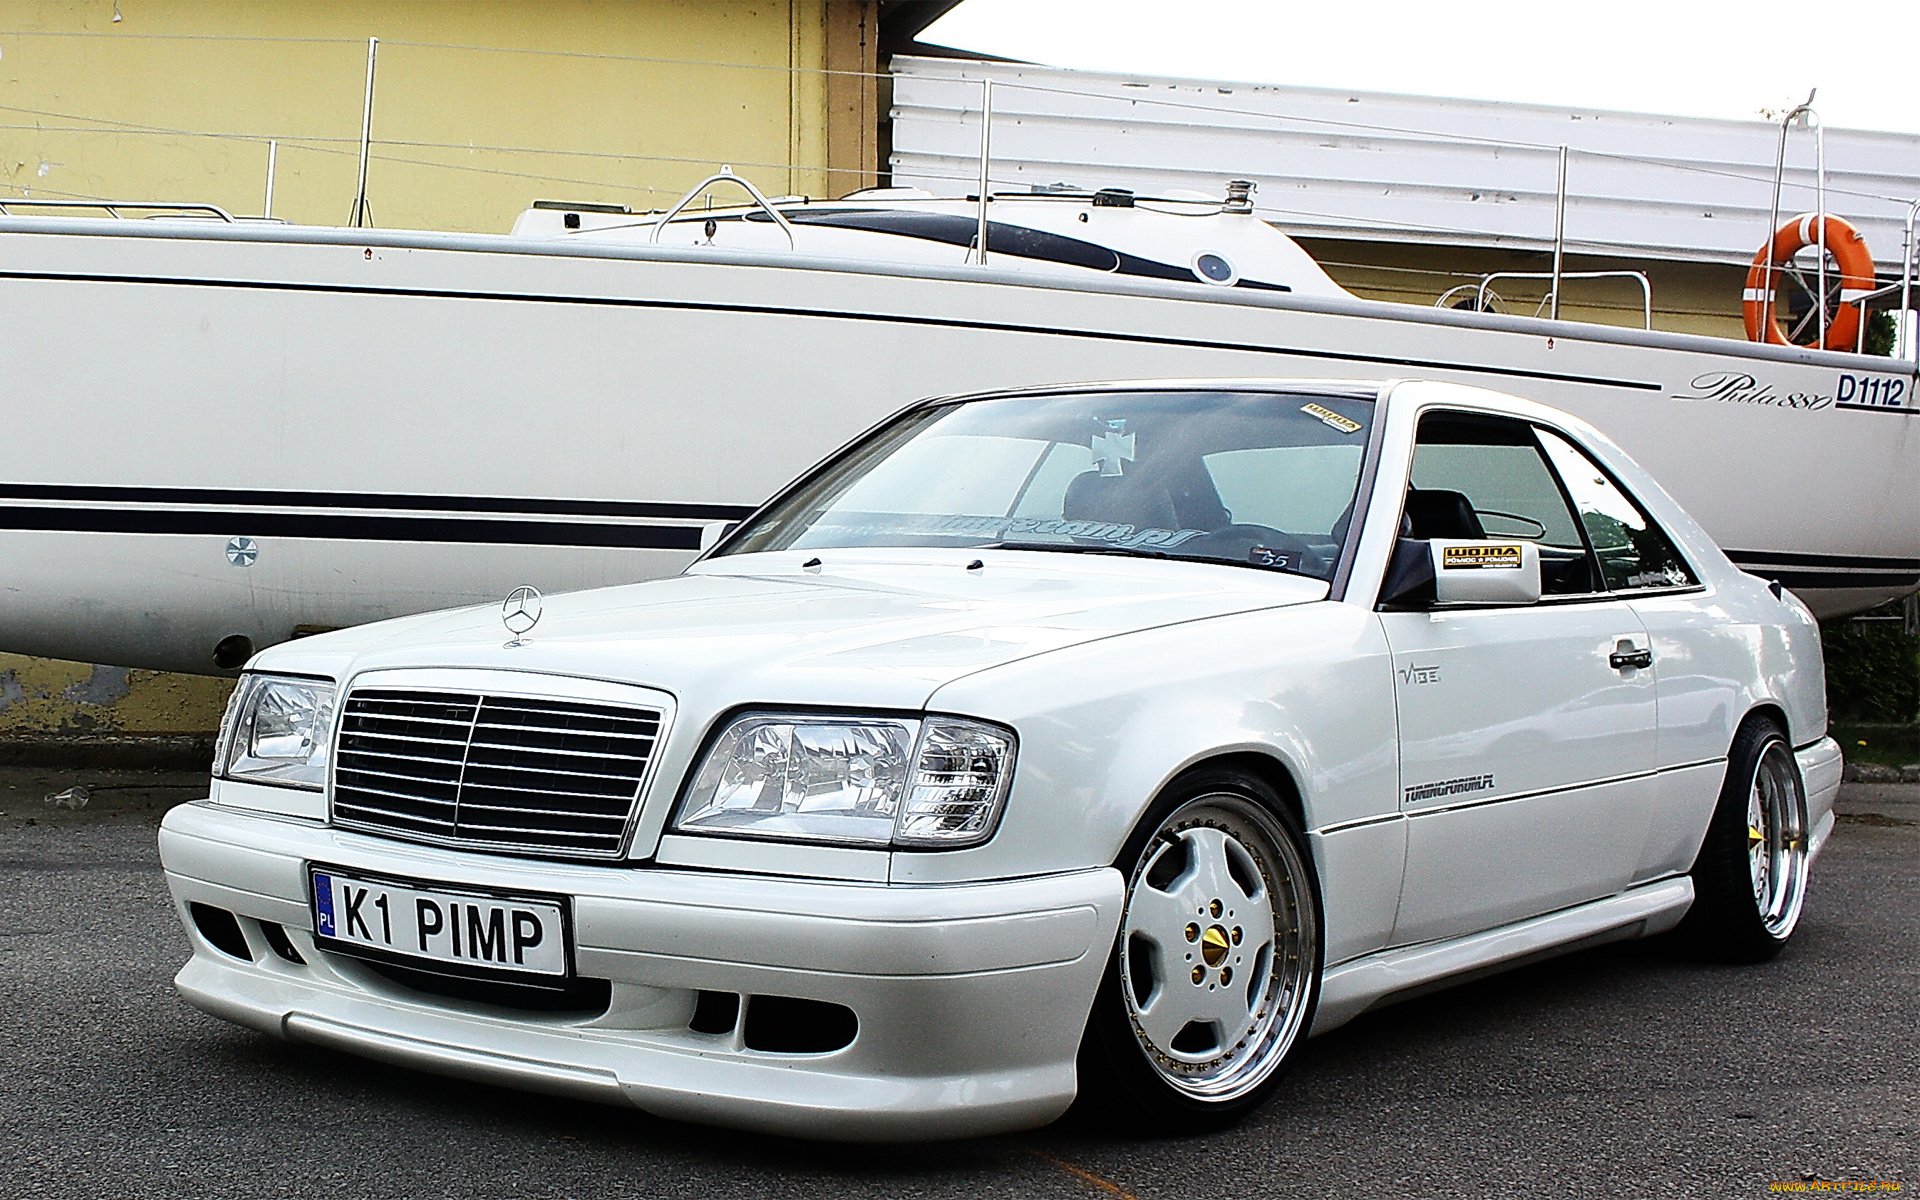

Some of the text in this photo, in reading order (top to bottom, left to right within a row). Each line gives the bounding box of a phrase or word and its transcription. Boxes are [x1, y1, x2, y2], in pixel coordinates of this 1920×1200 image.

[1669, 371, 1834, 412] Phila 880
[1836, 374, 1905, 406] D1112
[319, 884, 544, 965] PL K1 PIMP
